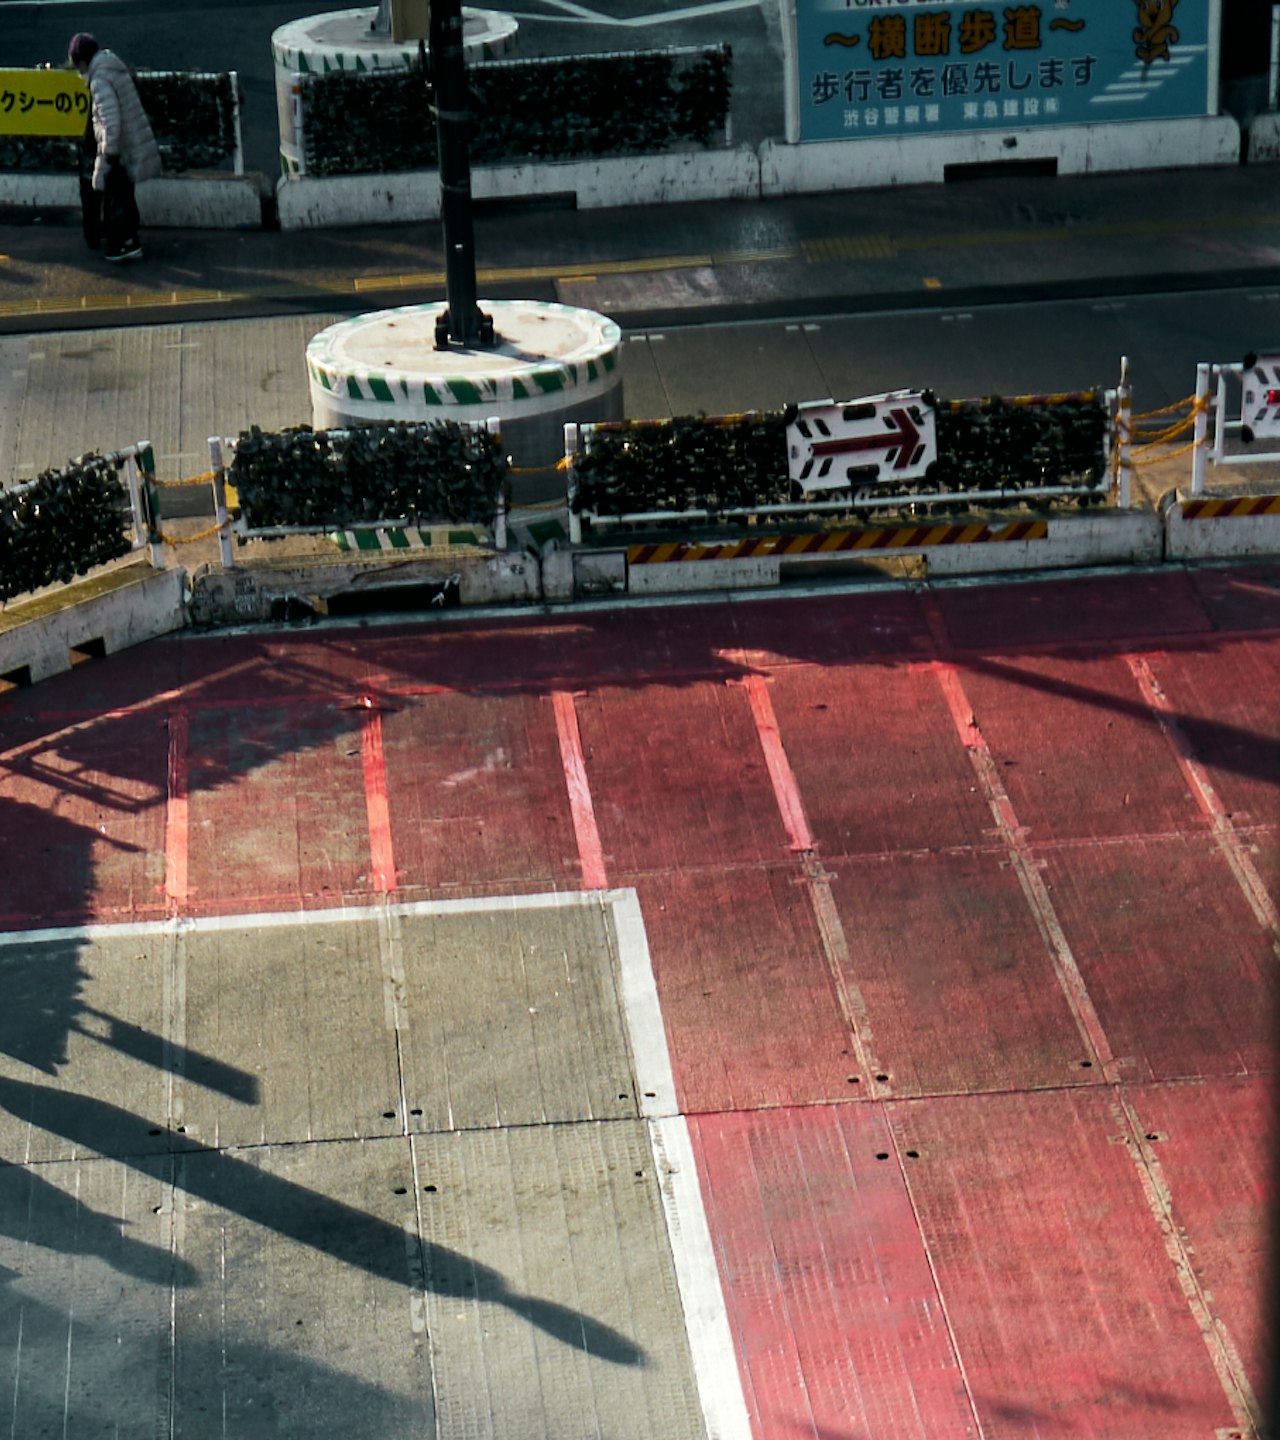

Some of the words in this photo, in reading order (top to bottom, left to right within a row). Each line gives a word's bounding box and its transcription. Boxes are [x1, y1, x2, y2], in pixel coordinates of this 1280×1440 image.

[811, 55, 1097, 106] 歩行者を優先します
